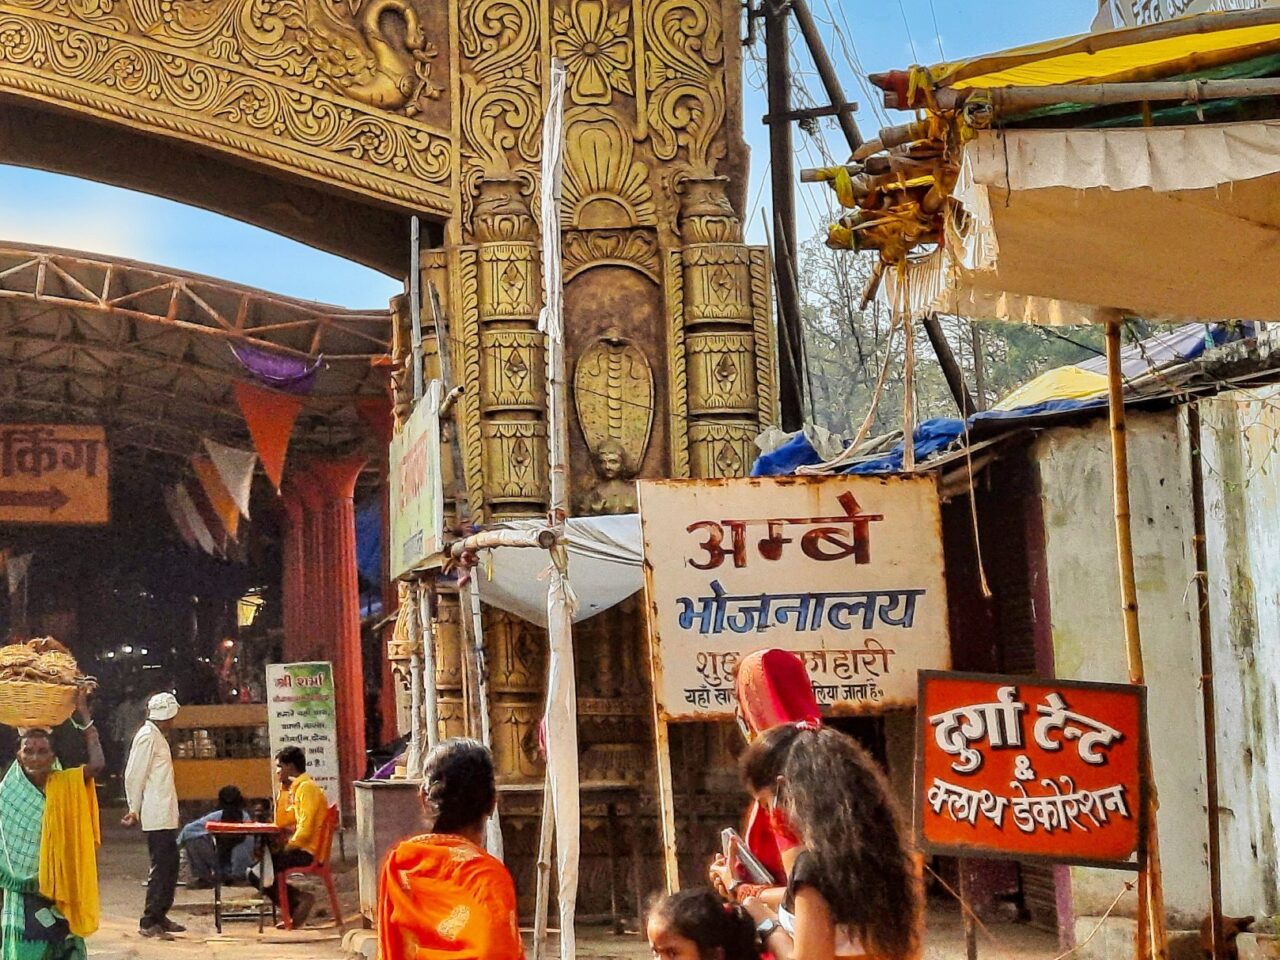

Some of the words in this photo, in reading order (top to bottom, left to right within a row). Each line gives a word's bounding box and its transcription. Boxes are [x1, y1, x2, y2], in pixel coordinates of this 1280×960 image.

[686, 491, 885, 570] अम्बे
[676, 580, 927, 634] भोजनालय
[841, 684, 868, 704] जाता
[929, 686, 1025, 772] दुर्गा
[1033, 692, 1123, 764] टेन्ट
[1014, 754, 1036, 781] &
[927, 776, 1008, 828] क्लाथ
[1010, 774, 1130, 834] डेकोरेशन
